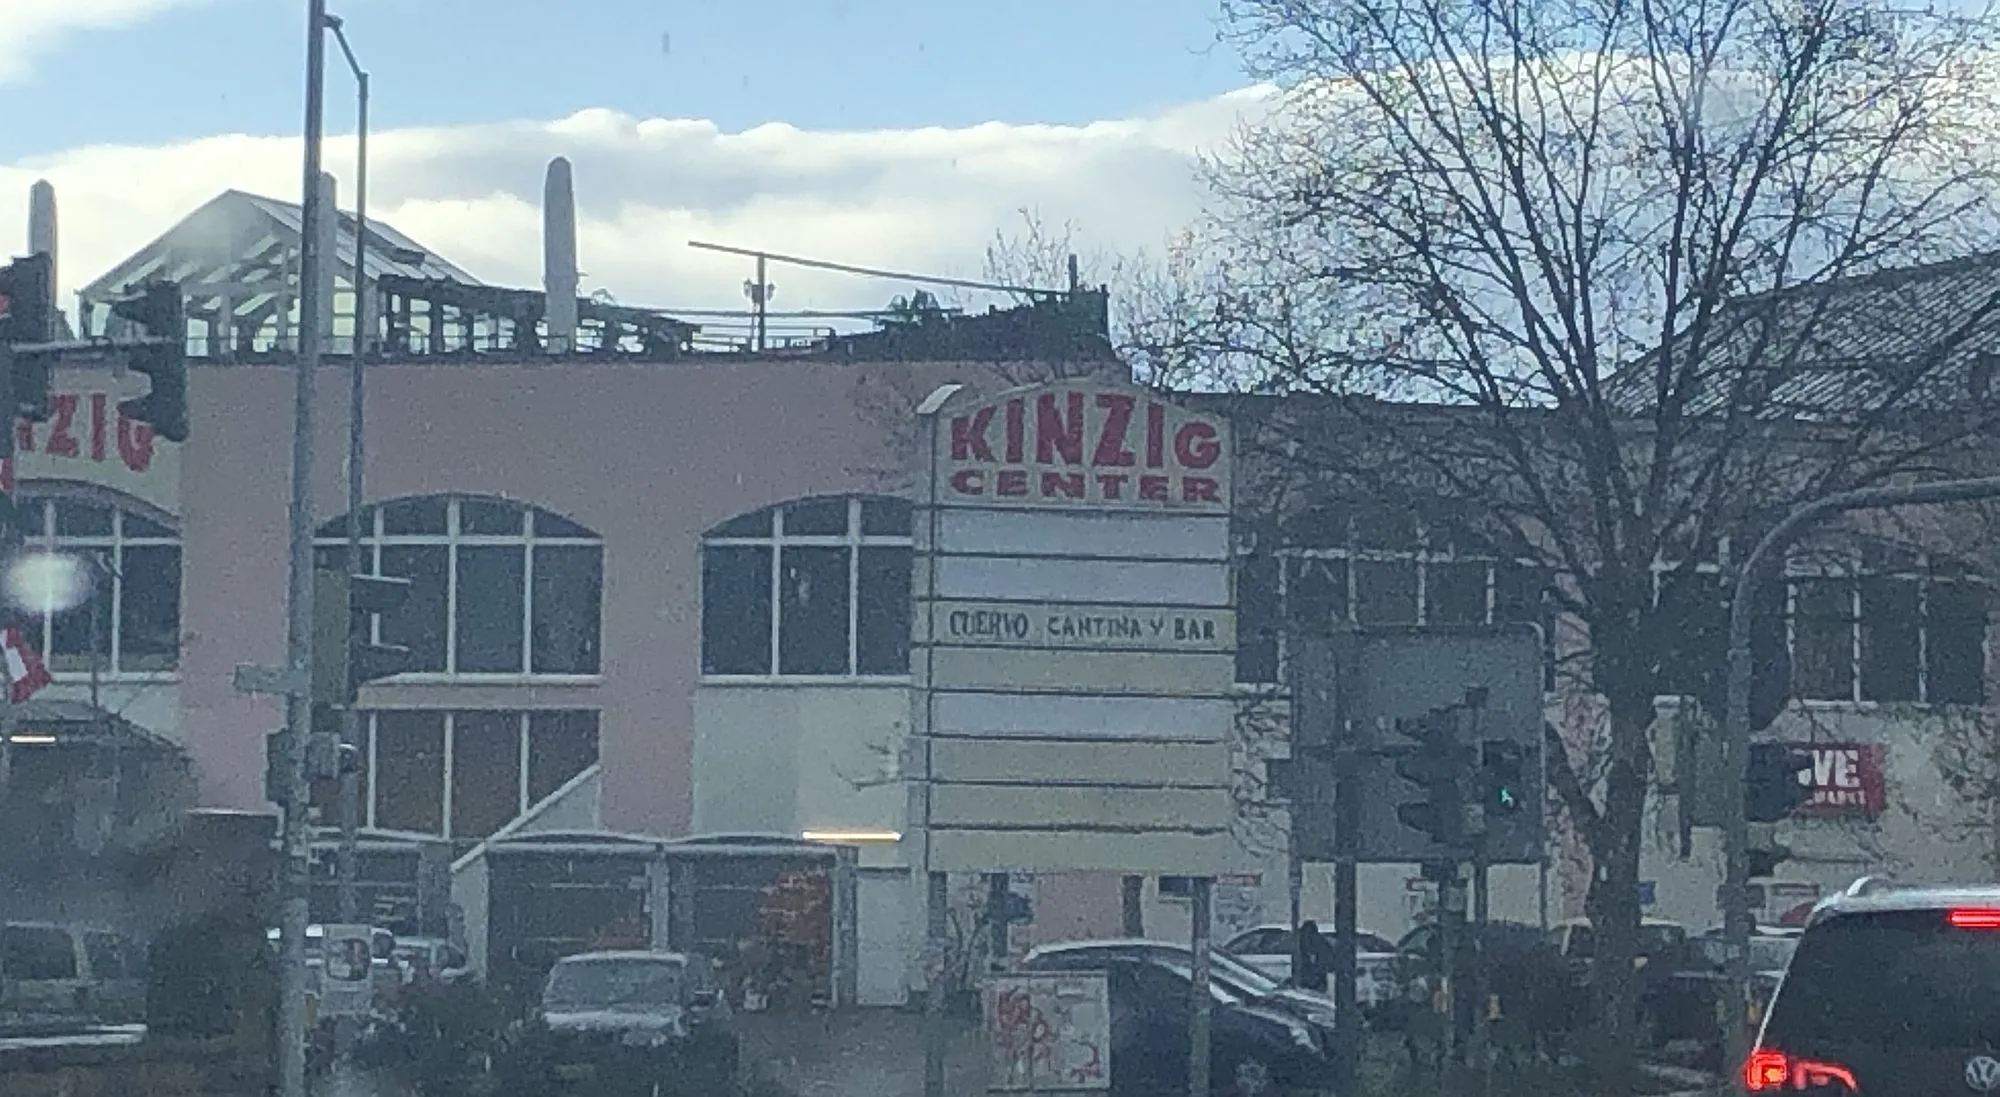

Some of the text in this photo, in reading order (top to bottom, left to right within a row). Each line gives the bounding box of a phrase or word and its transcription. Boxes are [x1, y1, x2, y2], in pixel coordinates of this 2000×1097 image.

[951, 391, 1221, 469] KINZIG
[951, 471, 1222, 504] CENTER
[949, 610, 1029, 638] CUERVO
[1047, 614, 1142, 640] CANTINA
[1174, 617, 1215, 641] BAR
